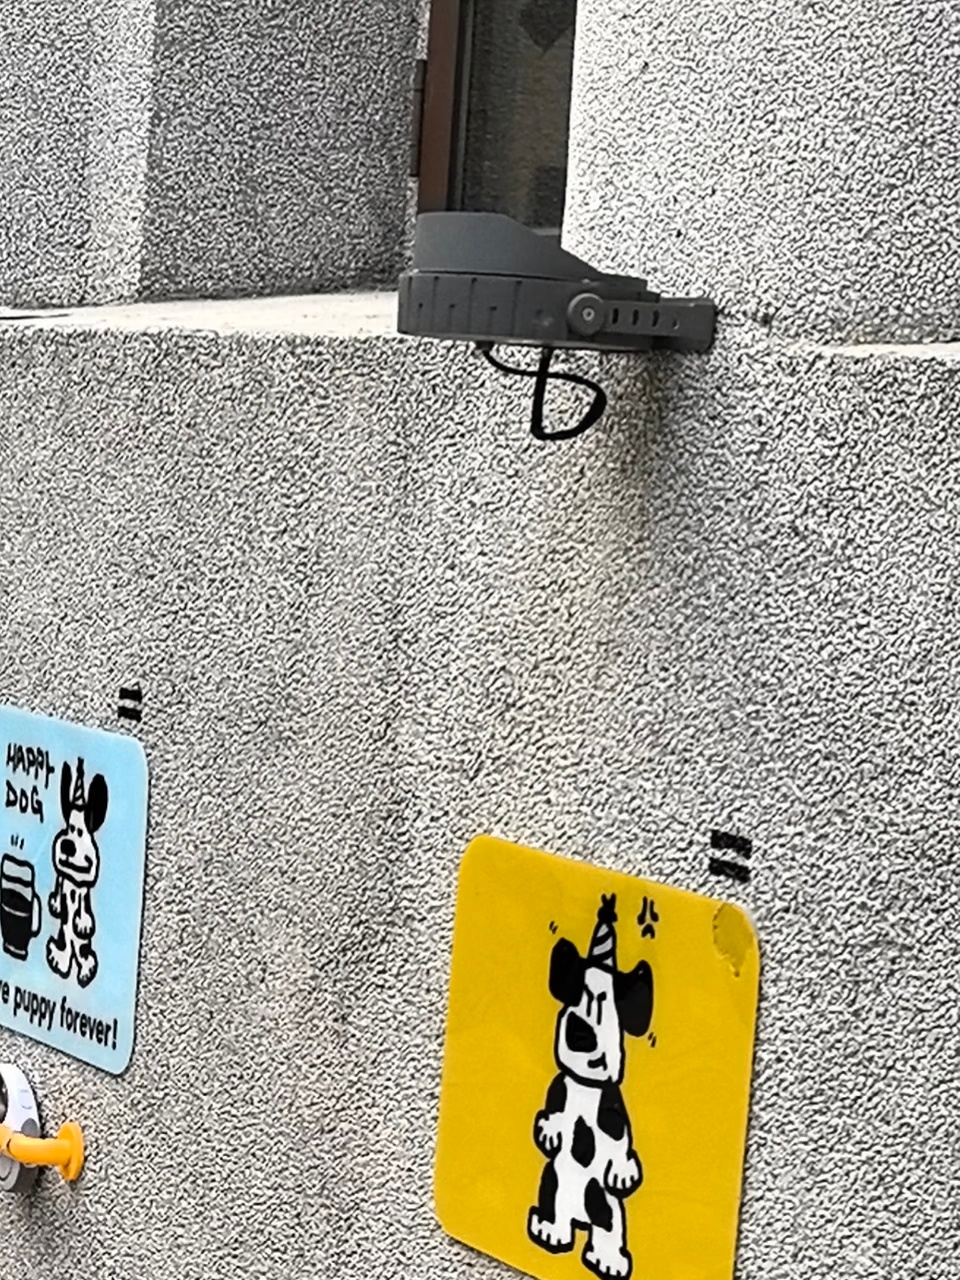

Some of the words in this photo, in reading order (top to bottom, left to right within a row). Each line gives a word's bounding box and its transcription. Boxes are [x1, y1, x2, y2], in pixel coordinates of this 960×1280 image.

[5, 742, 55, 790] HAPPY
[5, 779, 44, 824] DOG
[13, 986, 56, 1032] puppy
[60, 995, 118, 1051] forever!
